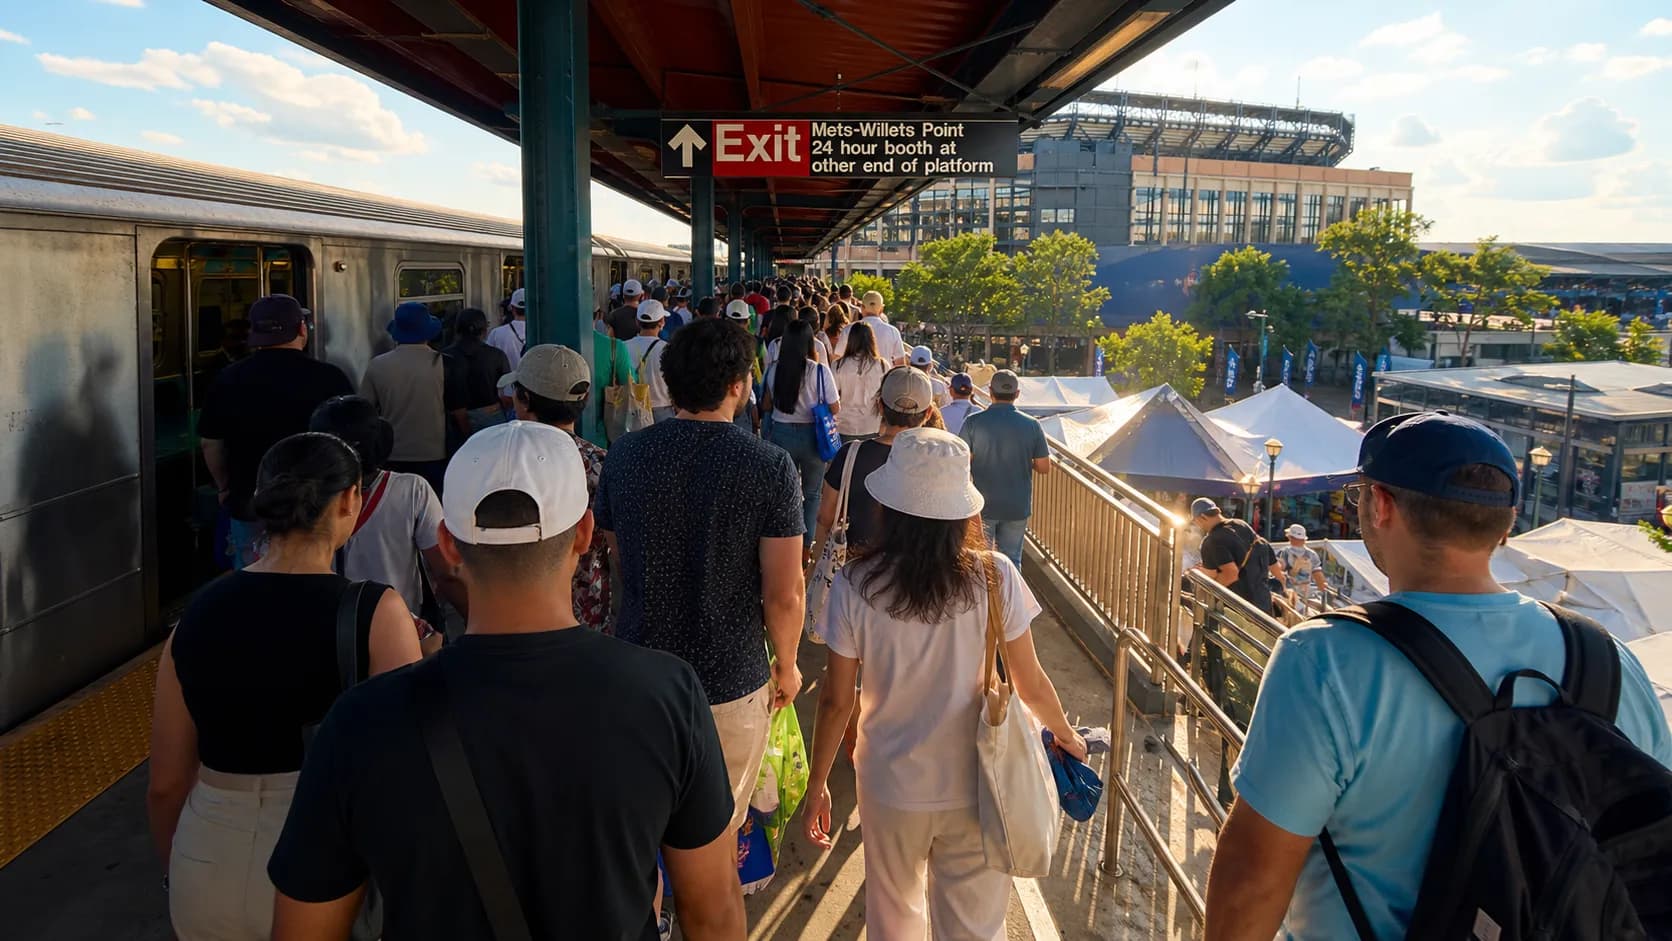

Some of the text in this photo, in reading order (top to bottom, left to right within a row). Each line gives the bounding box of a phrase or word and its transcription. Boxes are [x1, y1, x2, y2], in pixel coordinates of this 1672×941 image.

[813, 123, 964, 137] Mets-Willets Point
[717, 124, 801, 161] Exit
[812, 140, 956, 155] 24 hour booth at
[812, 158, 993, 175] other end of platform
